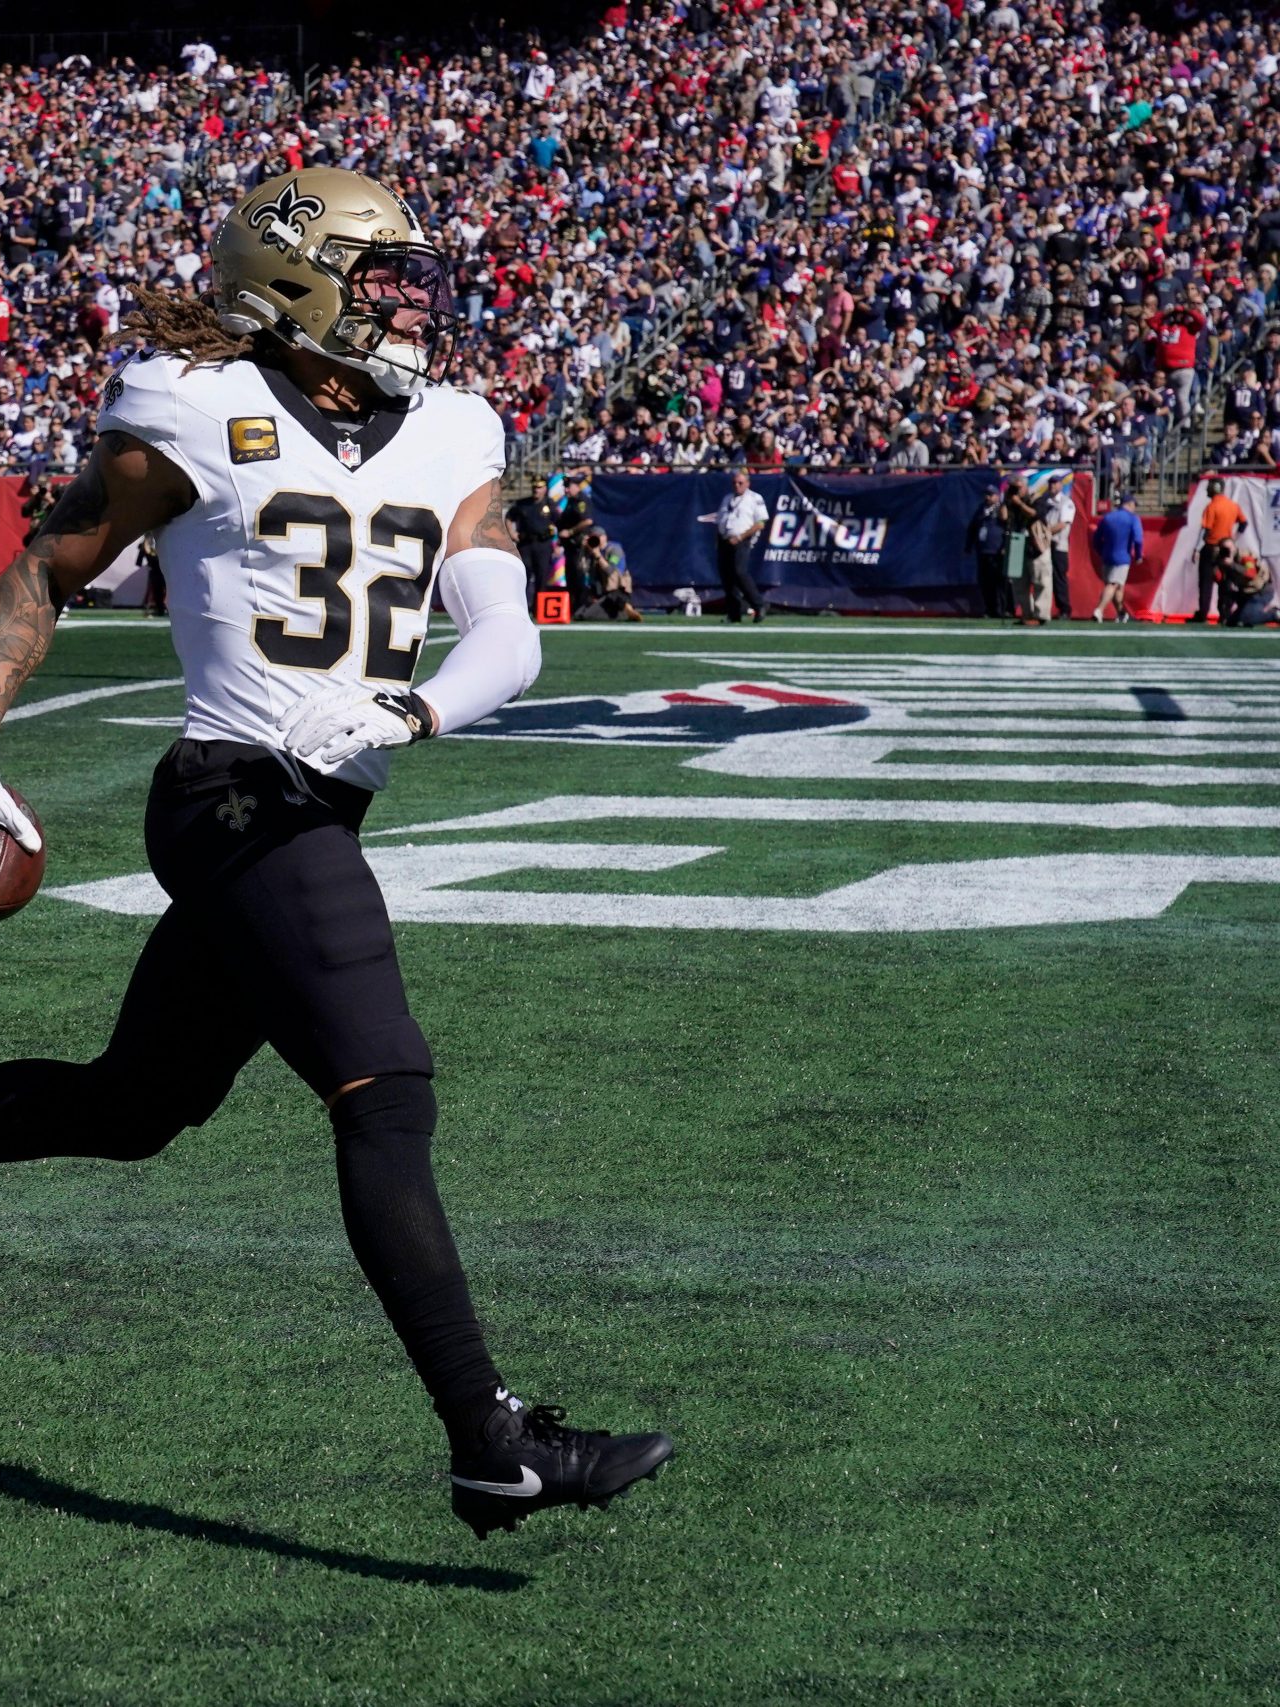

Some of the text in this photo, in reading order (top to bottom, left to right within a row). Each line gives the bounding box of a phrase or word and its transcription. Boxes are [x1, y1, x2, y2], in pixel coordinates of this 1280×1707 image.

[231, 418, 276, 450] C
[769, 513, 888, 550] CATCH
[764, 549, 880, 565] INTERCEPT CANCER
[250, 487, 444, 685] 32
[543, 596, 563, 619] G
